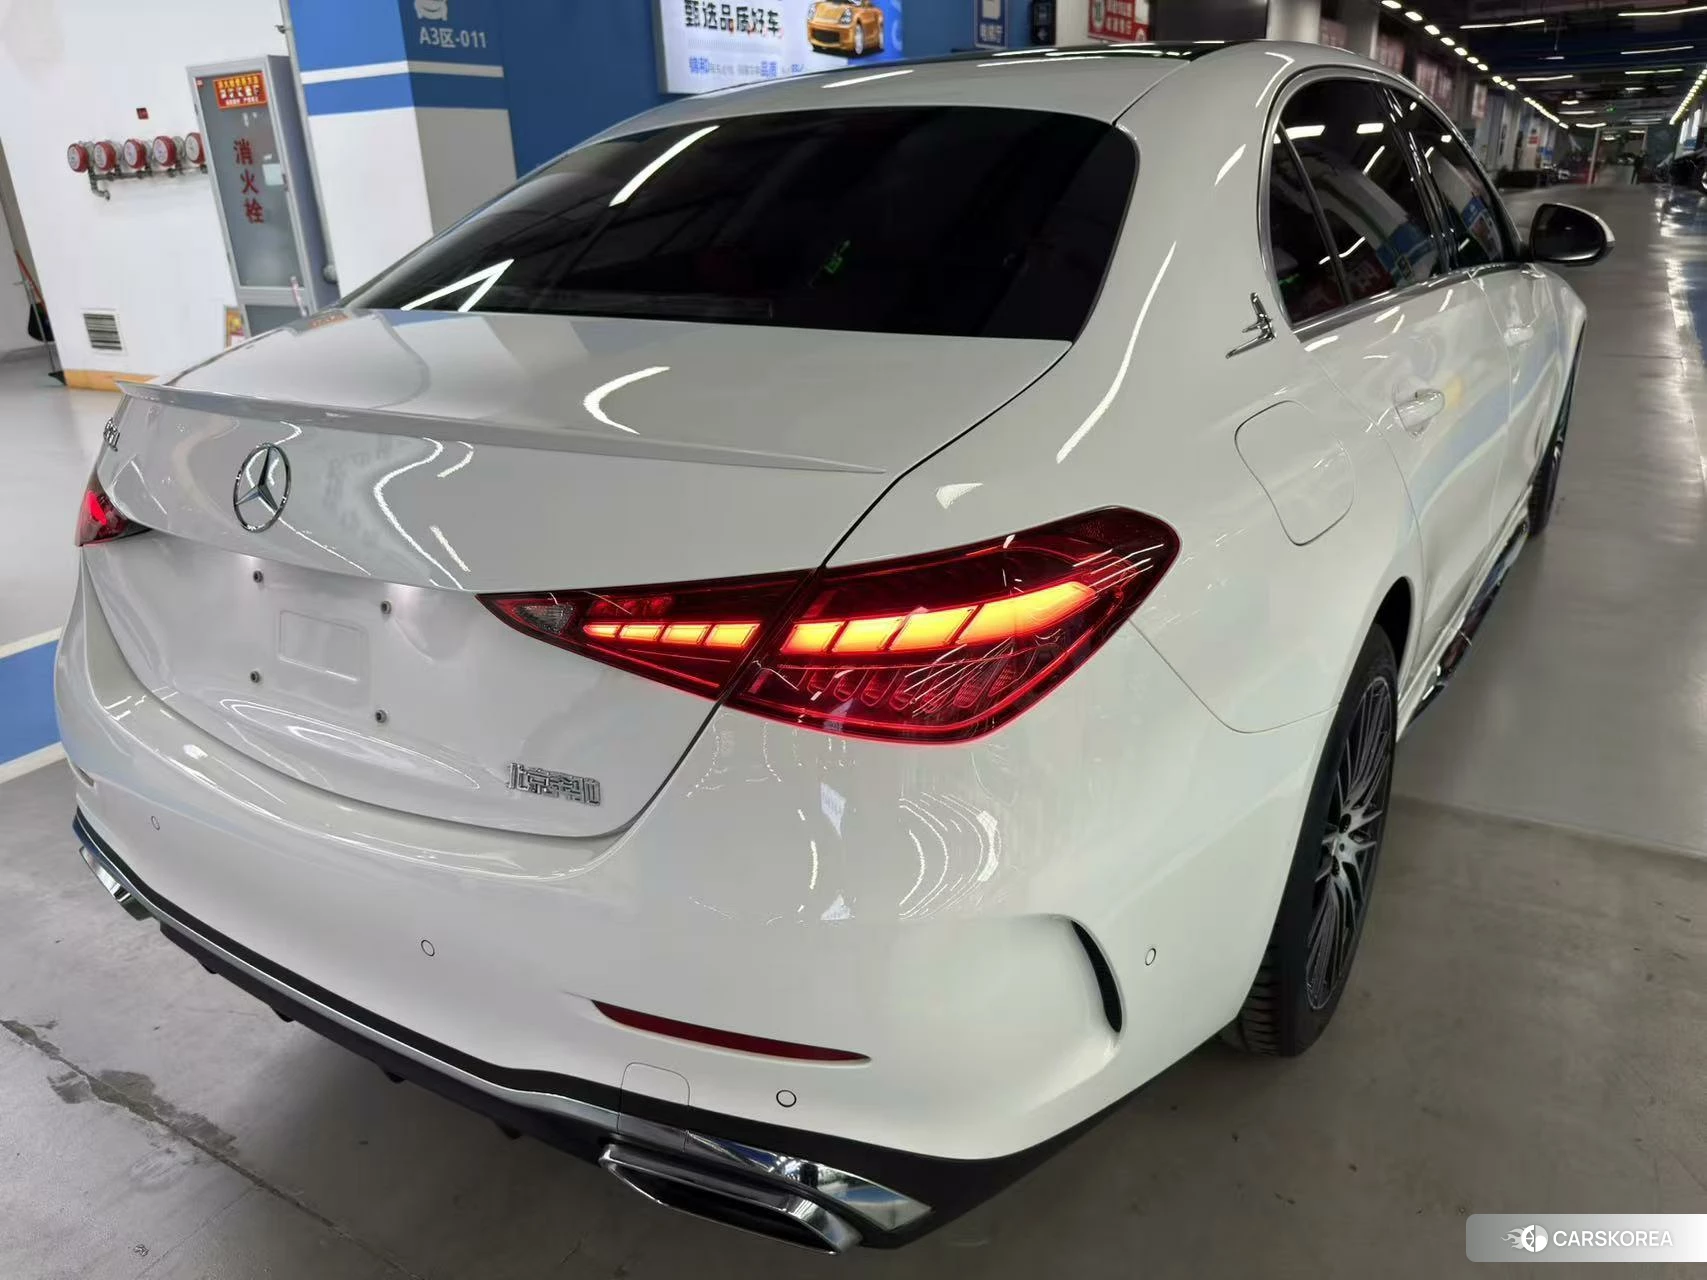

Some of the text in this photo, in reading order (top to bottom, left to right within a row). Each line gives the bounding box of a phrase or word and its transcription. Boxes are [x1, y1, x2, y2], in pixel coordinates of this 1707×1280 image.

[684, 0, 779, 36] 甄选品质好车
[419, 26, 487, 49] A3区-011
[233, 138, 264, 224] 消火栓
